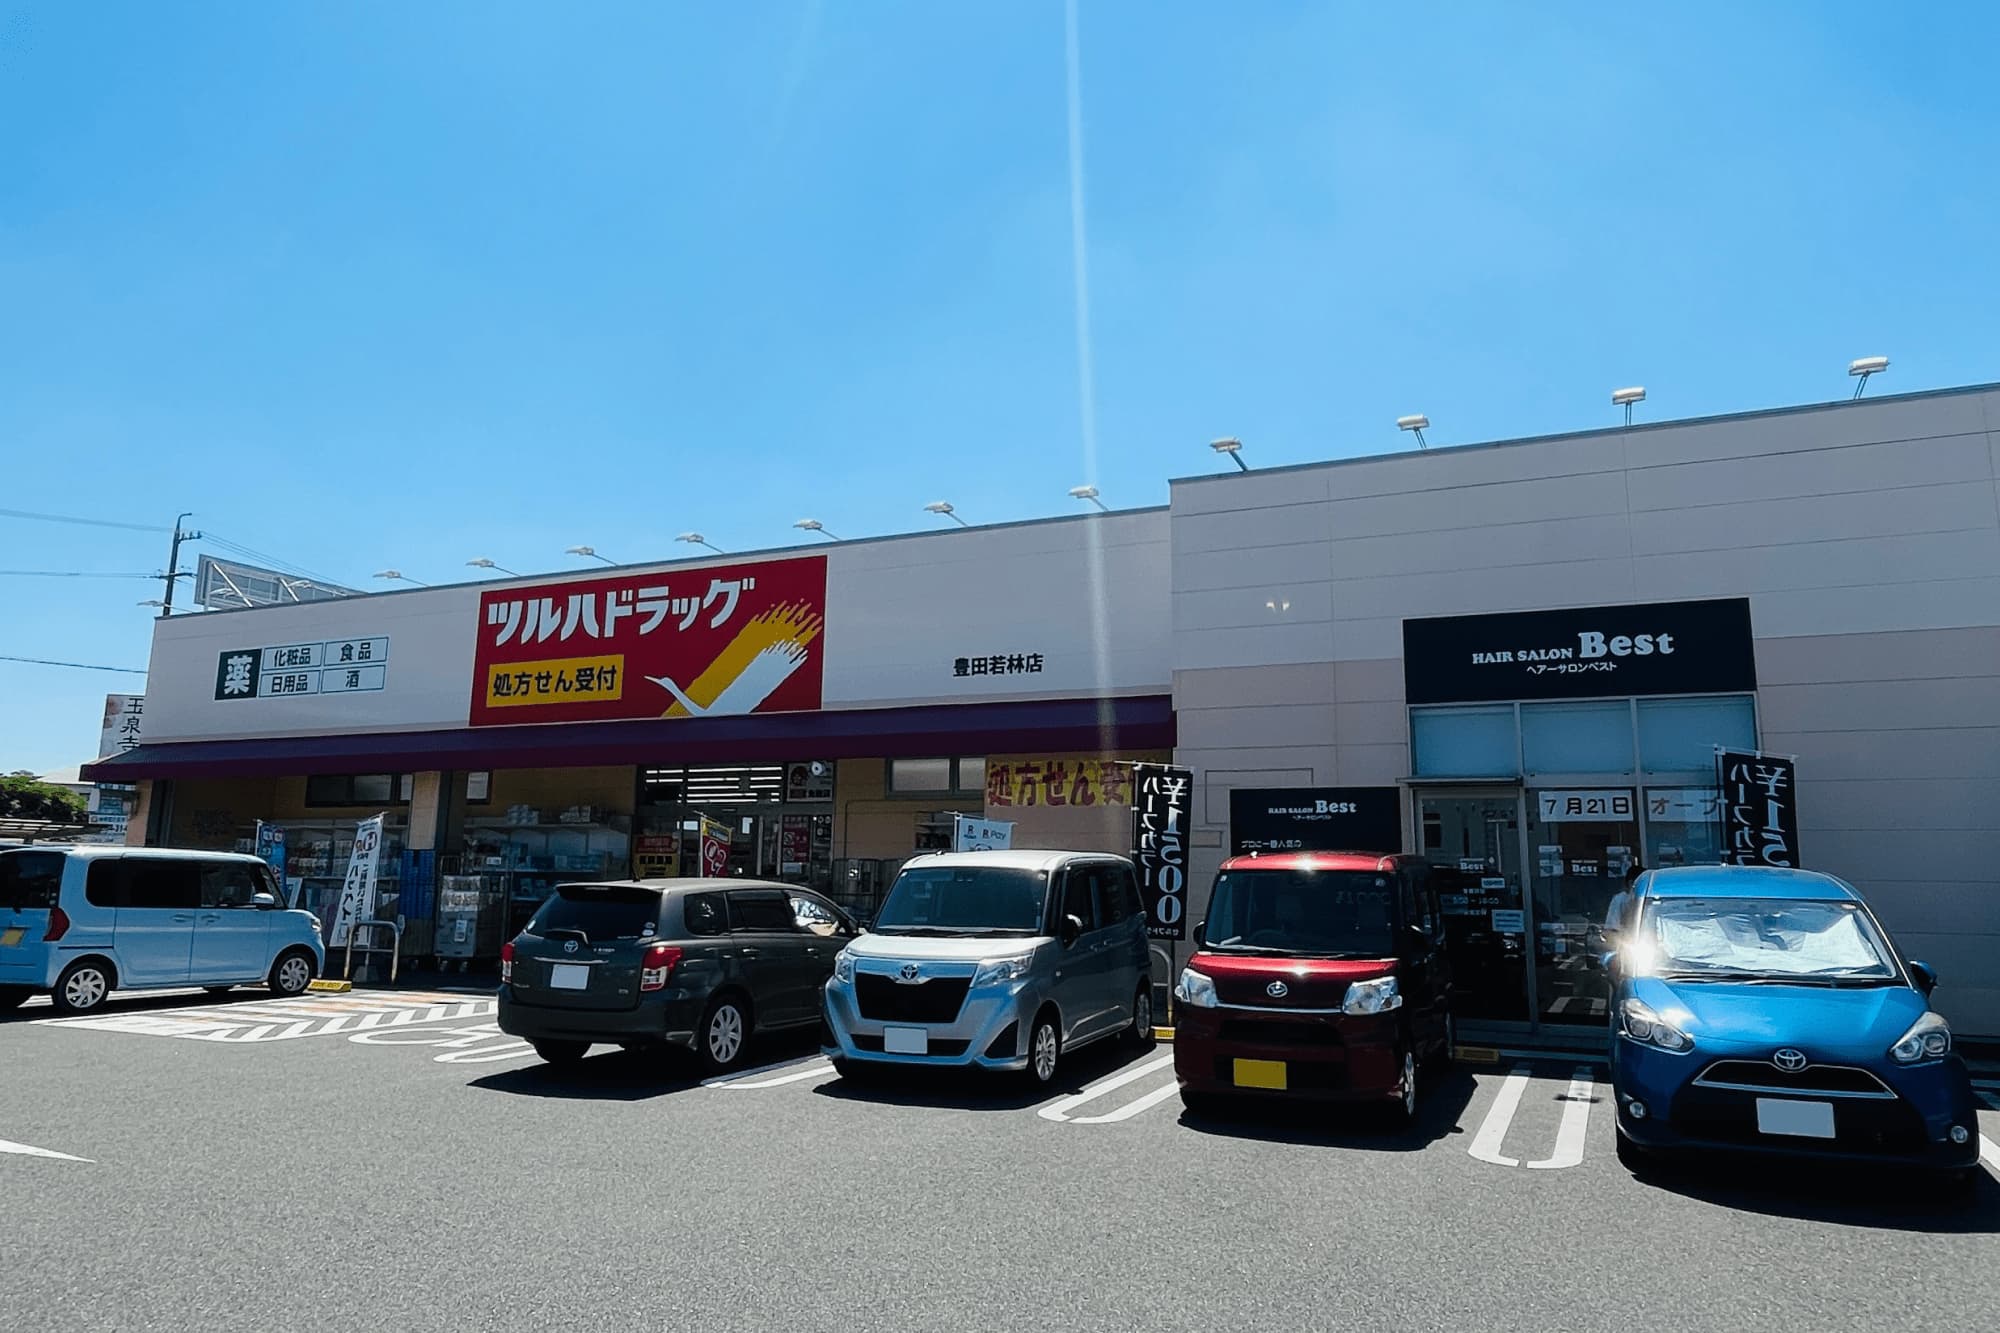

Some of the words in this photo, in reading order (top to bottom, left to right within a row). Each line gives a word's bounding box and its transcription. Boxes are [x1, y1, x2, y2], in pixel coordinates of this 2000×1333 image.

[487, 577, 756, 647] ツルハドラッグ
[274, 648, 311, 667] 化粧品
[340, 642, 371, 662] 食品
[1472, 652, 1514, 664] HAIR
[1517, 648, 1573, 662] SALON
[1577, 631, 1674, 659] Best
[224, 655, 253, 695] 薬
[953, 653, 1043, 677] 豊田若林店
[1526, 661, 1617, 675] ヘアーサロンベスト
[271, 674, 308, 693] 日用品
[345, 670, 360, 688] 酒
[492, 664, 617, 698] 処方せん受付
[117, 697, 144, 751] 玉泉寺
[987, 761, 1134, 807] 処方せん受
[1315, 800, 1357, 814] Best
[1545, 796, 1630, 815] 7月21日
